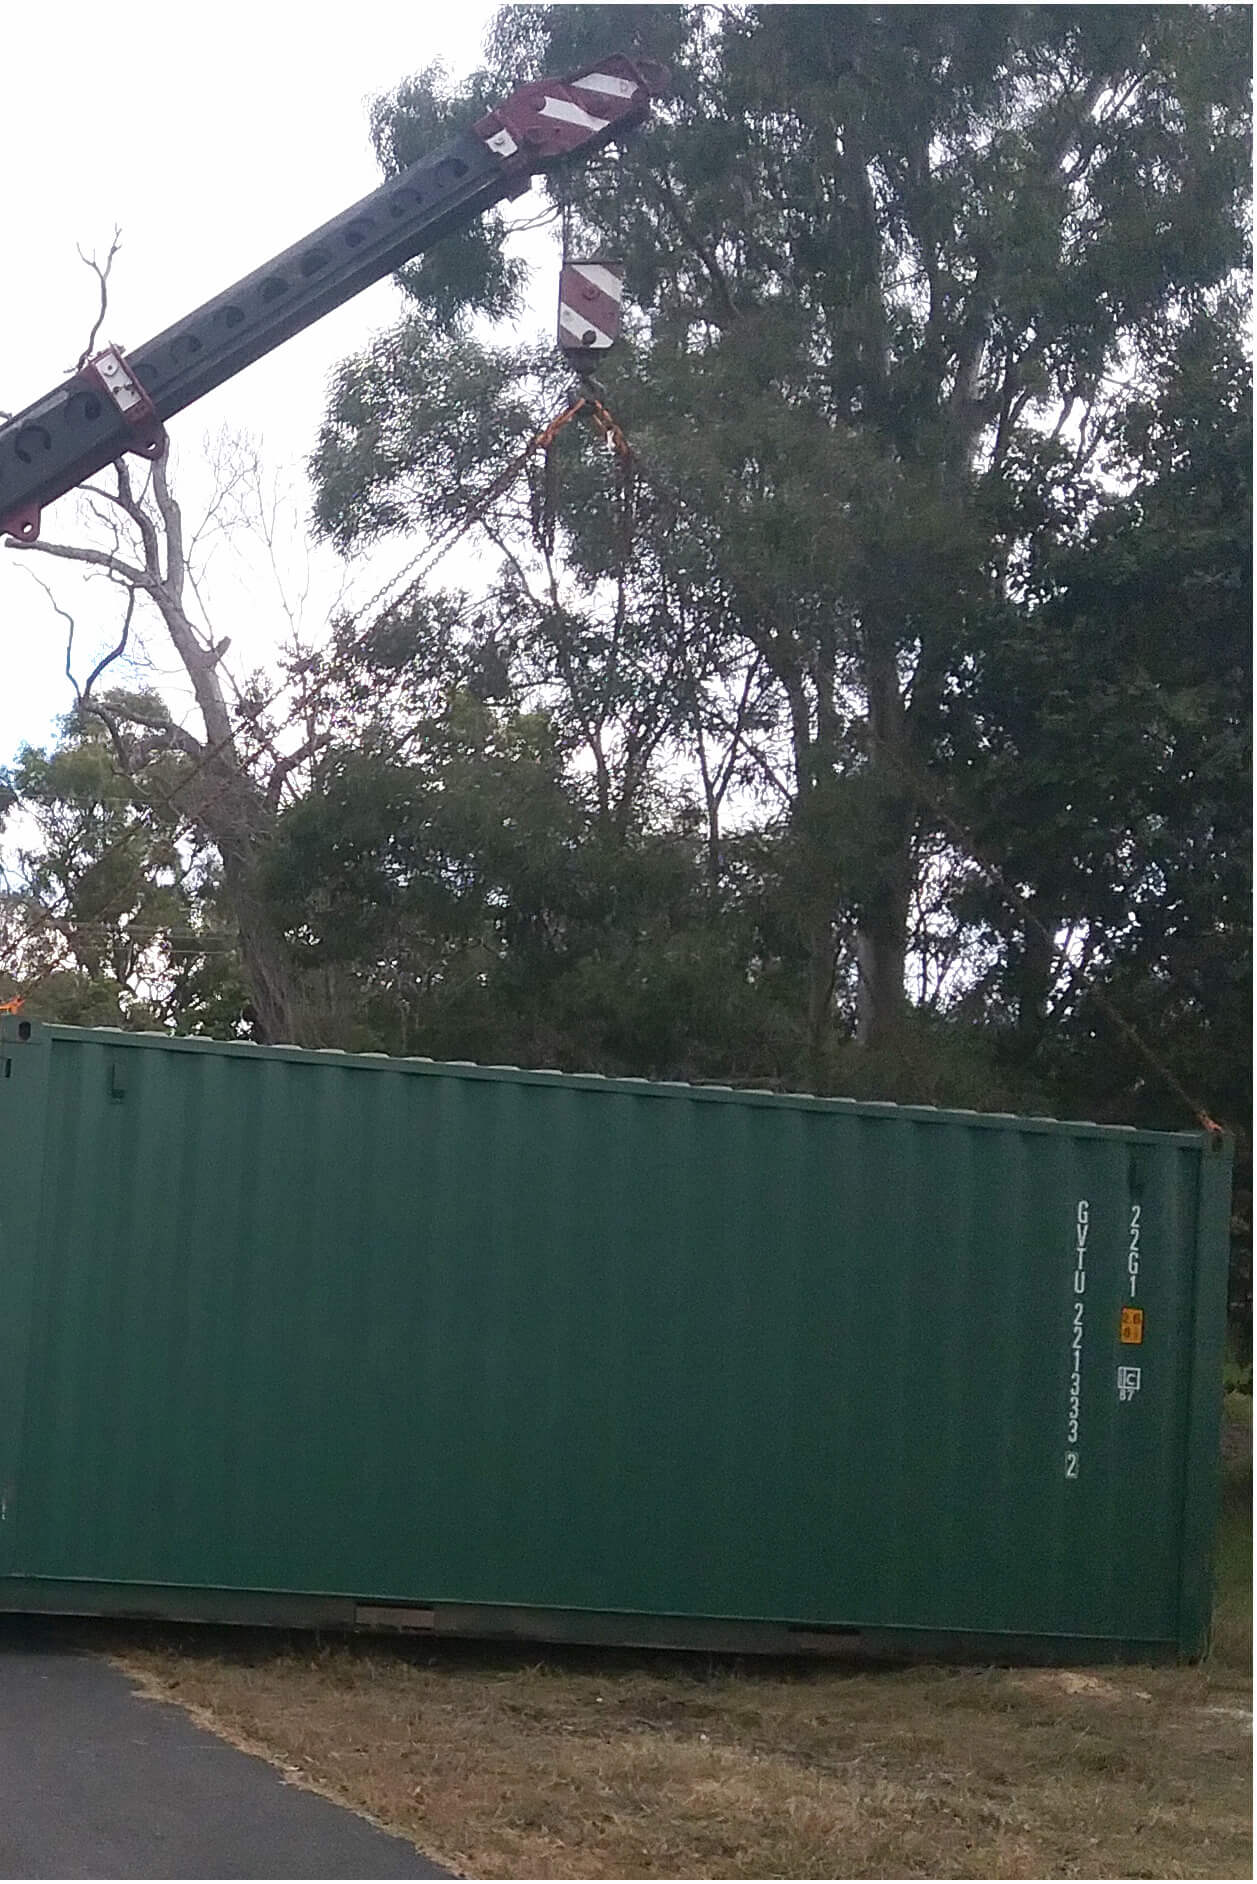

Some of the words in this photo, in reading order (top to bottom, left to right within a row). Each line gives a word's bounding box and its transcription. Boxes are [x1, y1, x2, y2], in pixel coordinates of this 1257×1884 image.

[1074, 1200, 1090, 1294] GVTU
[1127, 1205, 1142, 1298] 22G1
[1067, 1303, 1084, 1443] 221333
[1065, 1452, 1080, 1479] 2
